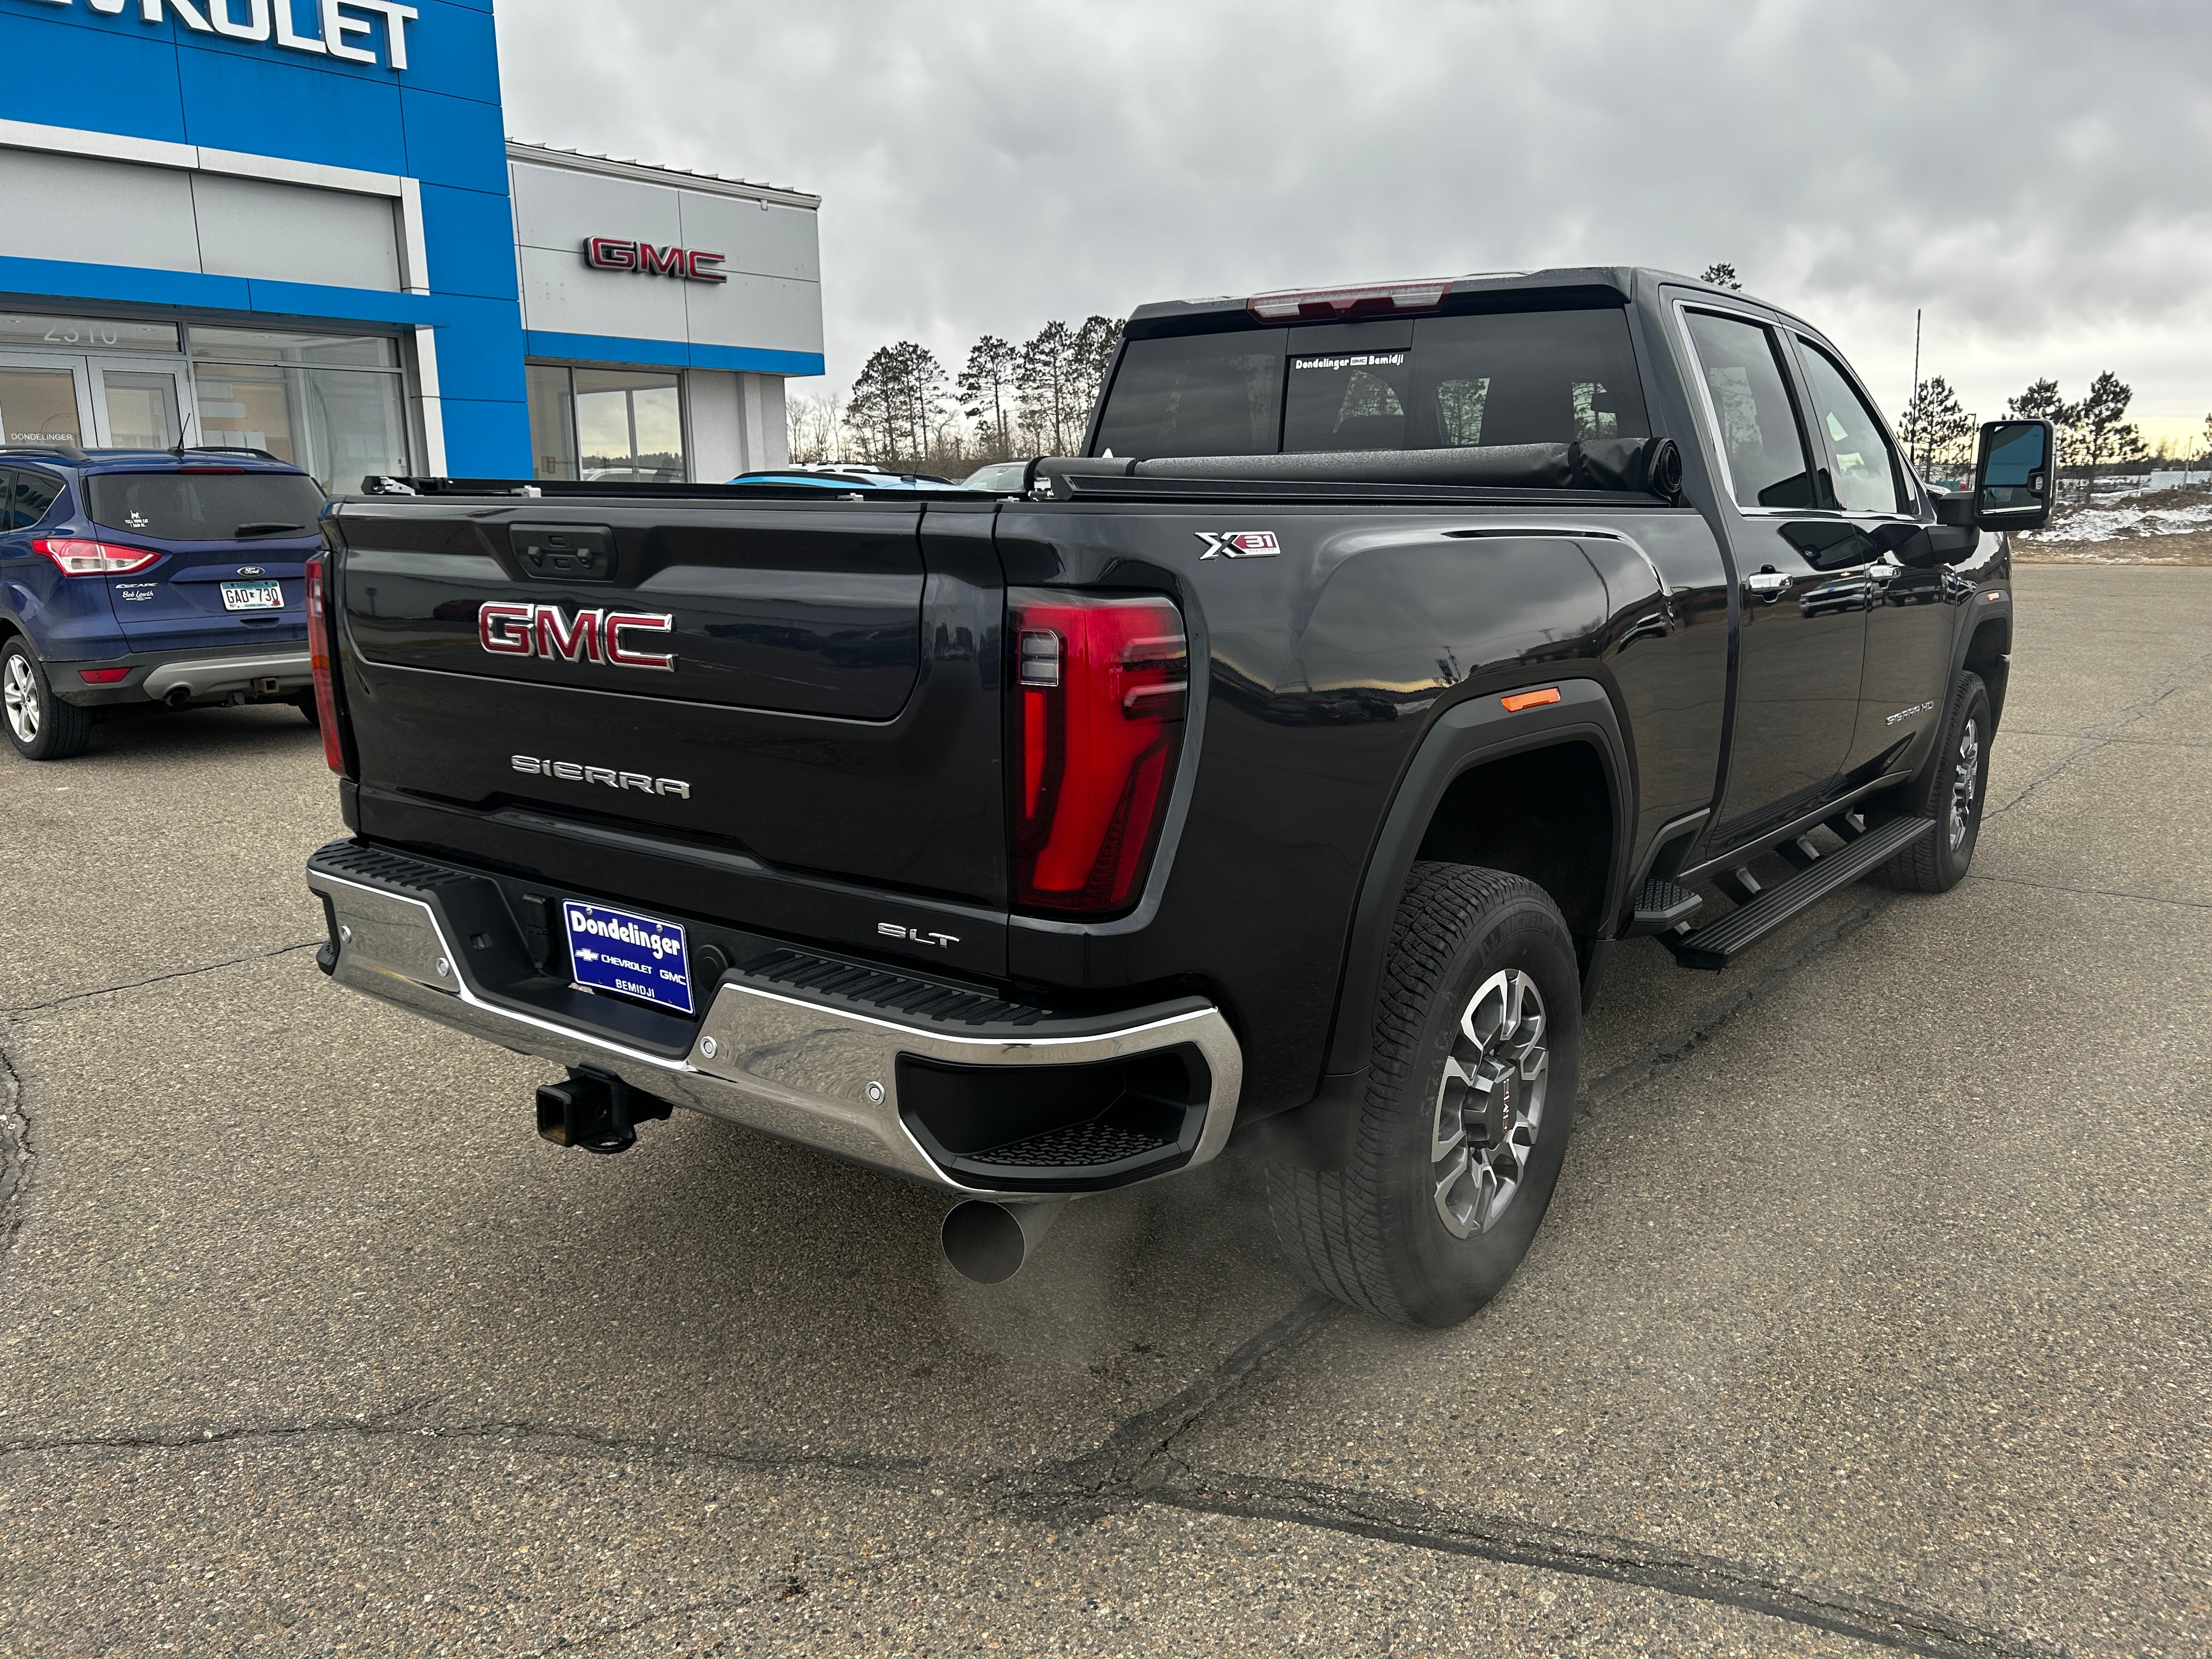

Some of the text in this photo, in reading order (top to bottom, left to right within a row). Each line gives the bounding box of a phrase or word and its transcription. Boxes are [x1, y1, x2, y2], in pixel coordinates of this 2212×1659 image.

[584, 236, 727, 283] GMC
[1296, 359, 1349, 370] Dondelinger
[1369, 354, 1404, 365] Bemidji
[1194, 532, 1281, 560] X31
[226, 588, 279, 603] GAD 730
[478, 601, 679, 673] GMC
[1886, 701, 1934, 725] SIERRA HD
[511, 755, 691, 799] SIERRA
[570, 910, 680, 960] Dondelinger
[878, 923, 961, 949] SLT
[601, 954, 686, 985] CHEVROLET GMC
[615, 978, 655, 998] BEMIDJI
